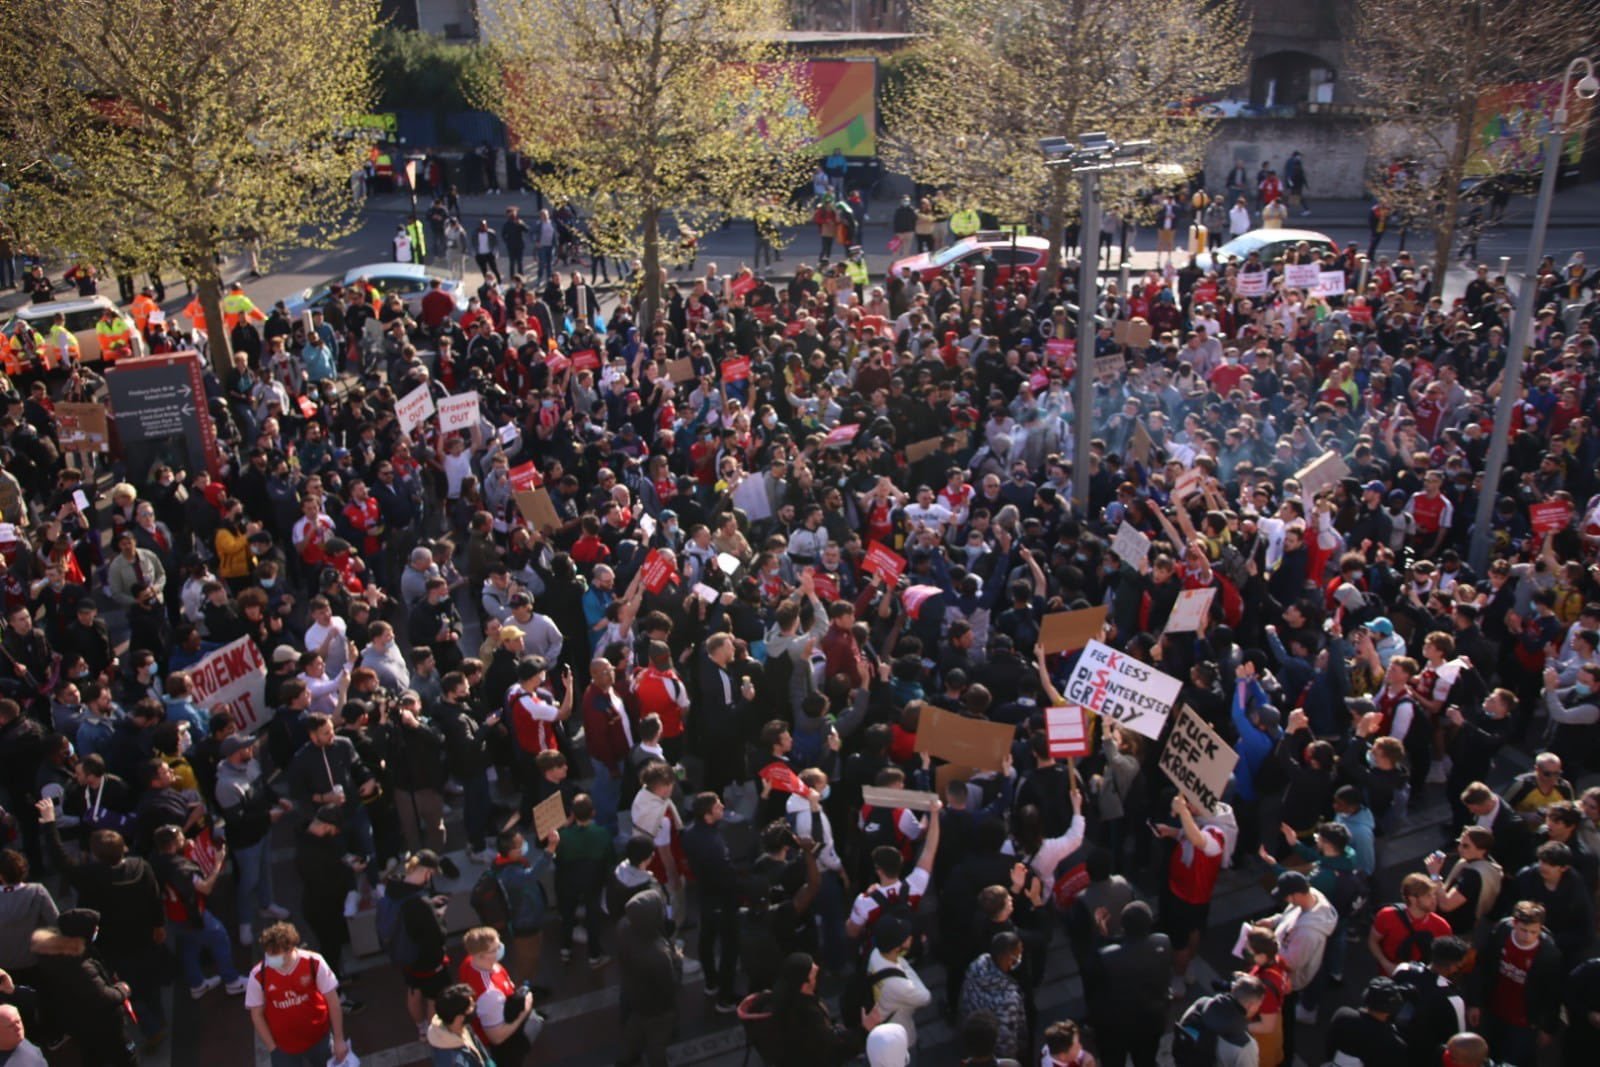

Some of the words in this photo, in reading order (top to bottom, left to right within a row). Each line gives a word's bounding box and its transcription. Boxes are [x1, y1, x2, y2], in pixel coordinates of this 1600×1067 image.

[409, 405, 425, 422] OUT
[440, 399, 477, 413] Kroenke
[449, 411, 469, 424] OUT
[1070, 680, 1144, 723] GREEDY
[1077, 667, 1171, 715] DISINTERESTED
[1171, 731, 1202, 763] OFF
[1178, 712, 1219, 760] FUCK
[1161, 747, 1219, 813] KROENKE
